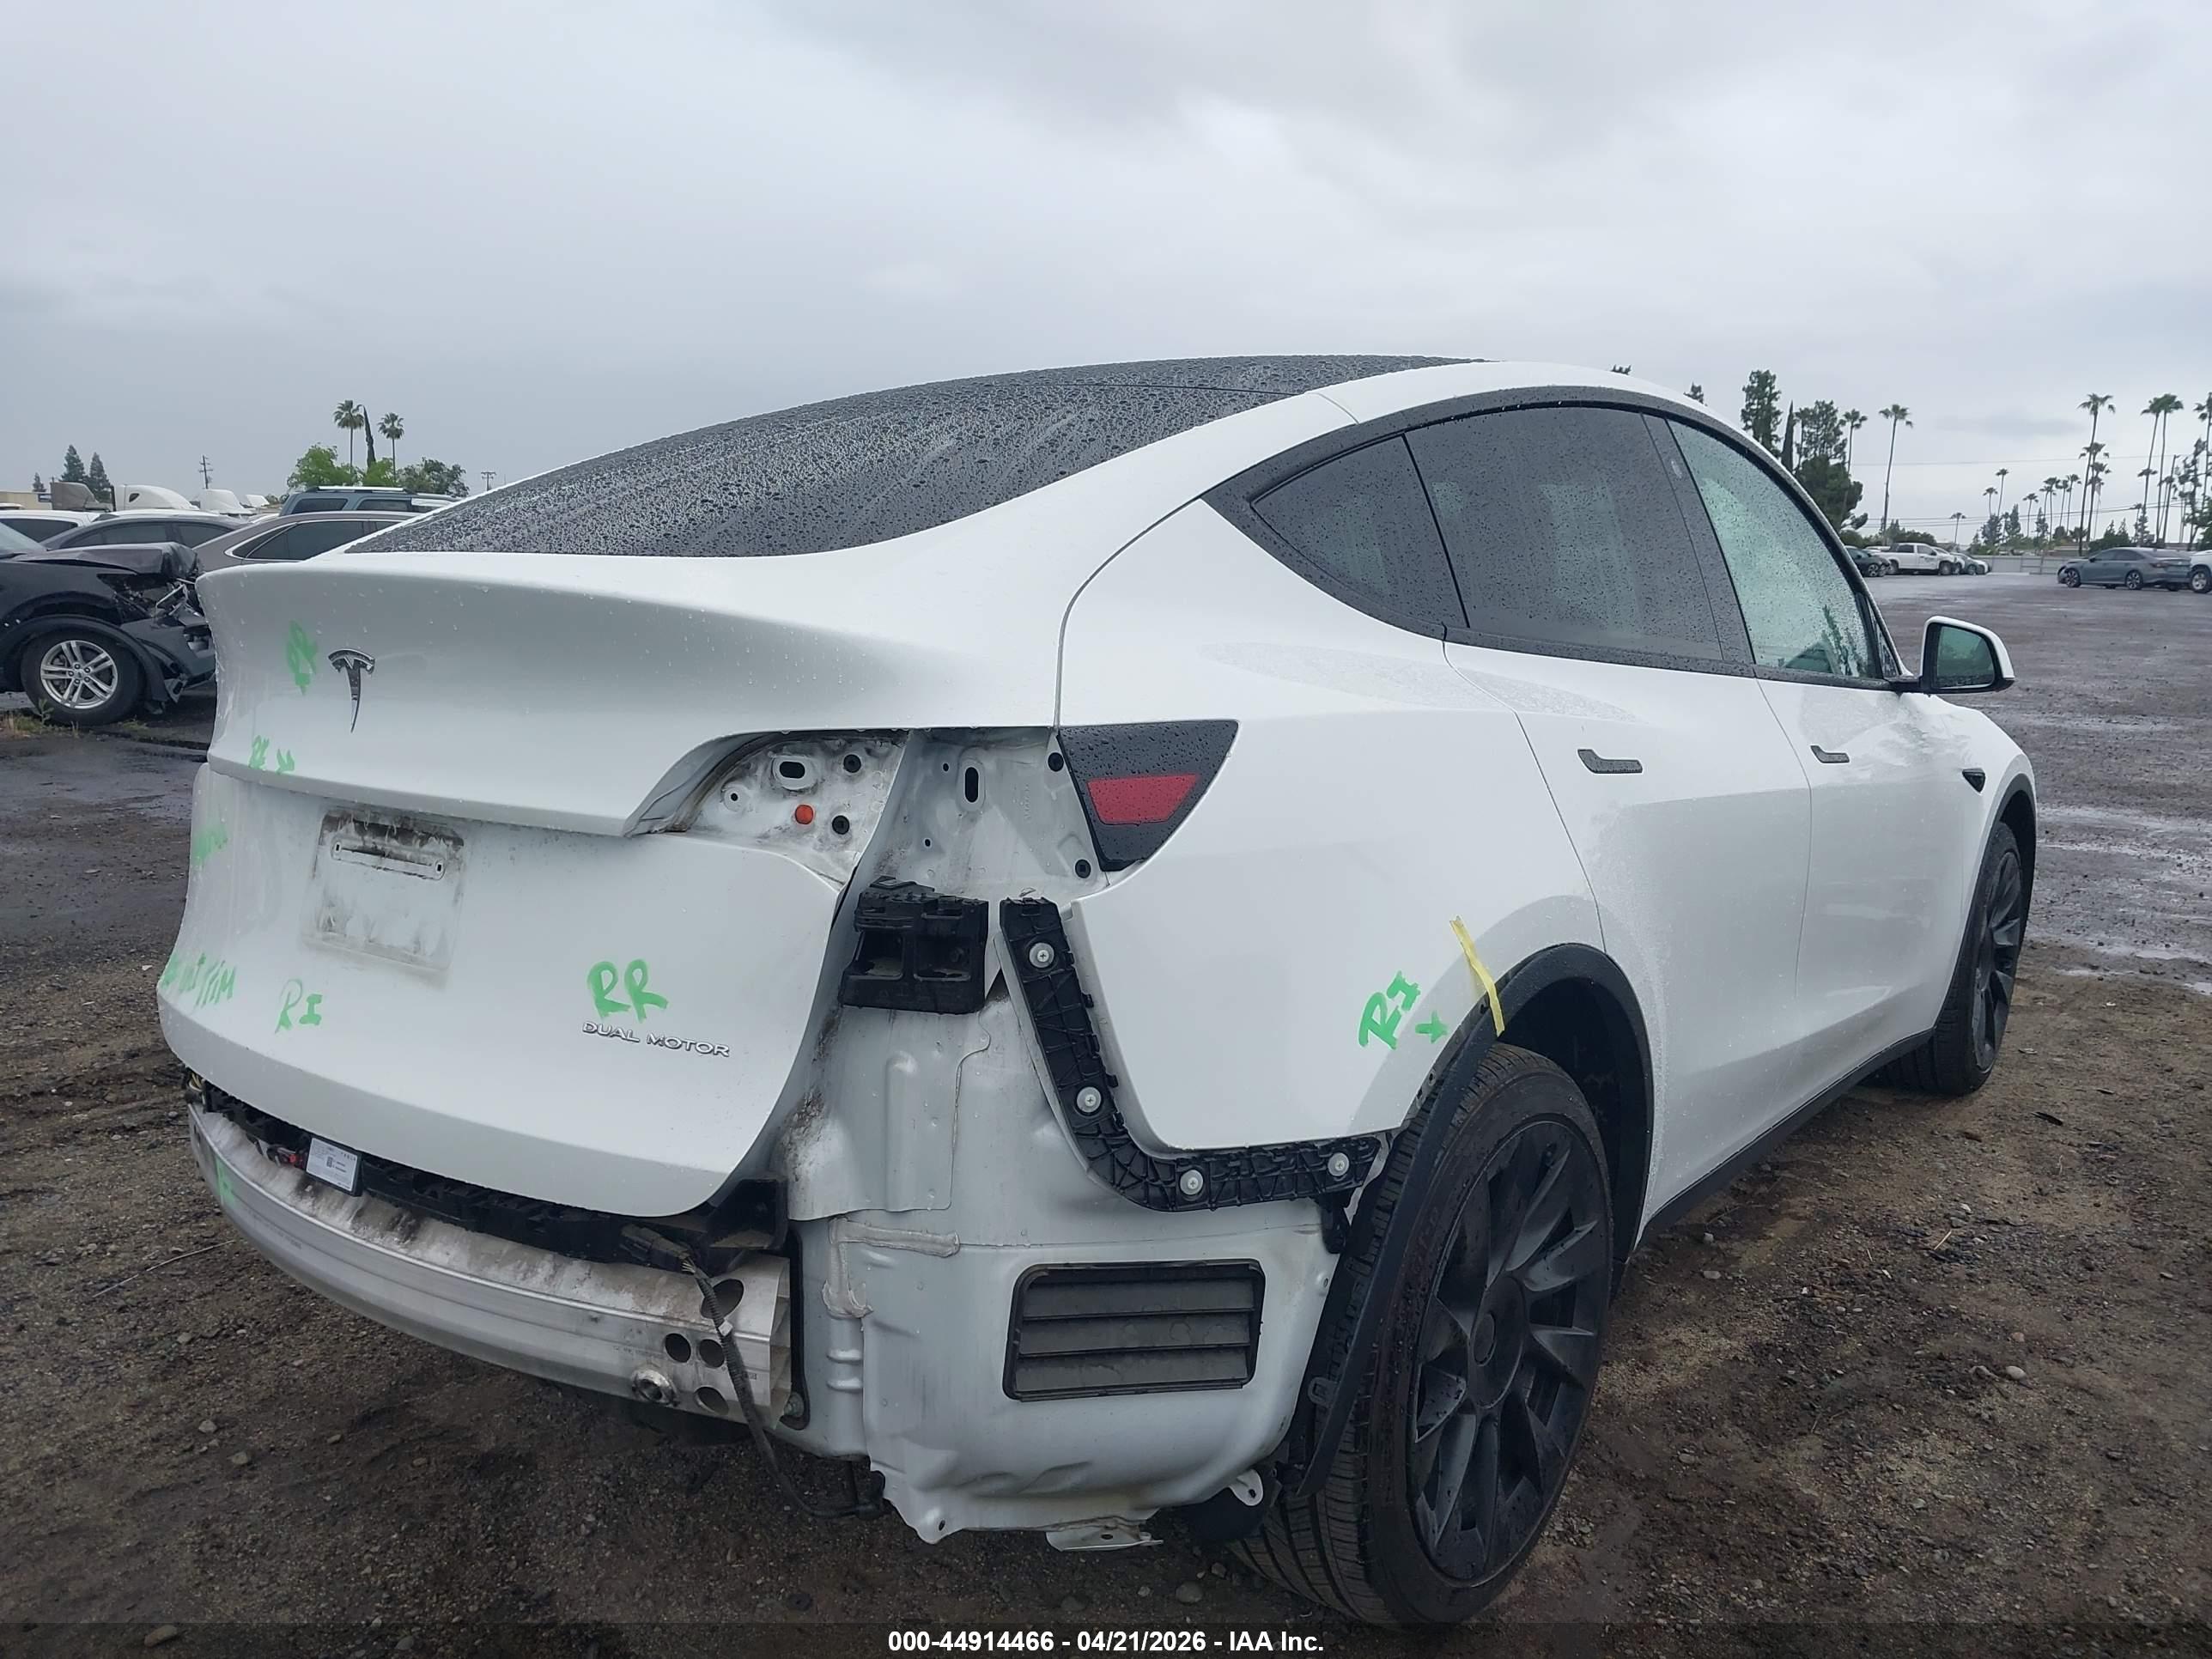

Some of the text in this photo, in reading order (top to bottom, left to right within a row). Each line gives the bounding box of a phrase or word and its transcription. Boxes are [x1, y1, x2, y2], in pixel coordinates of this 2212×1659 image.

[586, 959, 670, 1023] RR
[582, 1021, 730, 1057] DUAL MOTOR
